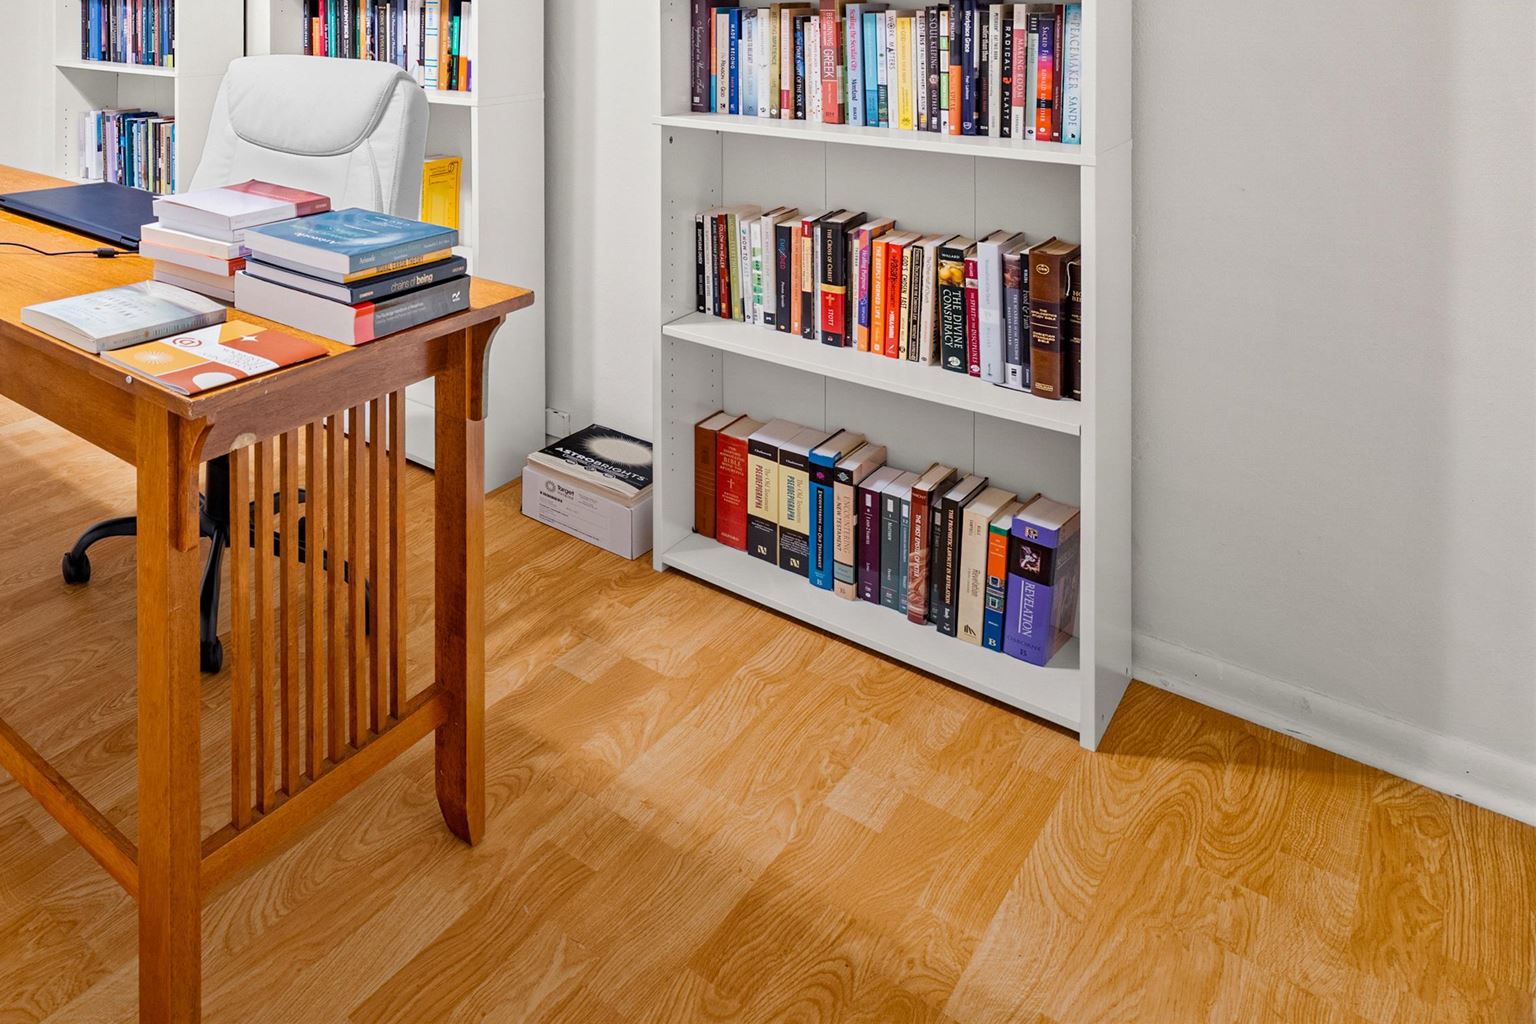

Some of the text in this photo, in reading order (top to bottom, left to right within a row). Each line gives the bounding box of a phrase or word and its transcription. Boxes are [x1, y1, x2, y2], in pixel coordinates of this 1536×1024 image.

[826, 12, 834, 47] BEGINNING
[849, 9, 857, 30] Scaling
[930, 18, 938, 39] SOUL
[886, 16, 895, 70] WORK MATTERS
[1004, 26, 1012, 71] RADICAL
[1069, 22, 1080, 89] PEACEMAKER
[823, 49, 834, 78] GREEK
[1068, 96, 1078, 127] SANDE
[742, 253, 747, 261] TO
[390, 279, 410, 292] chains
[416, 273, 434, 285] being
[943, 289, 953, 348] CONSPIRACY
[952, 291, 963, 349] THE DIVINE
[1022, 290, 1030, 329] Food Faith
[555, 447, 646, 482] ASTROBRIGHTS
[557, 485, 575, 496] Target
[755, 464, 763, 509] PSEUDEPIGRAPHA
[787, 475, 795, 521] PSEUDEPIGRAPHA
[843, 496, 851, 553] ENCOUNTERING
[971, 569, 981, 597] Revelation
[1023, 582, 1035, 638] REVELATION
